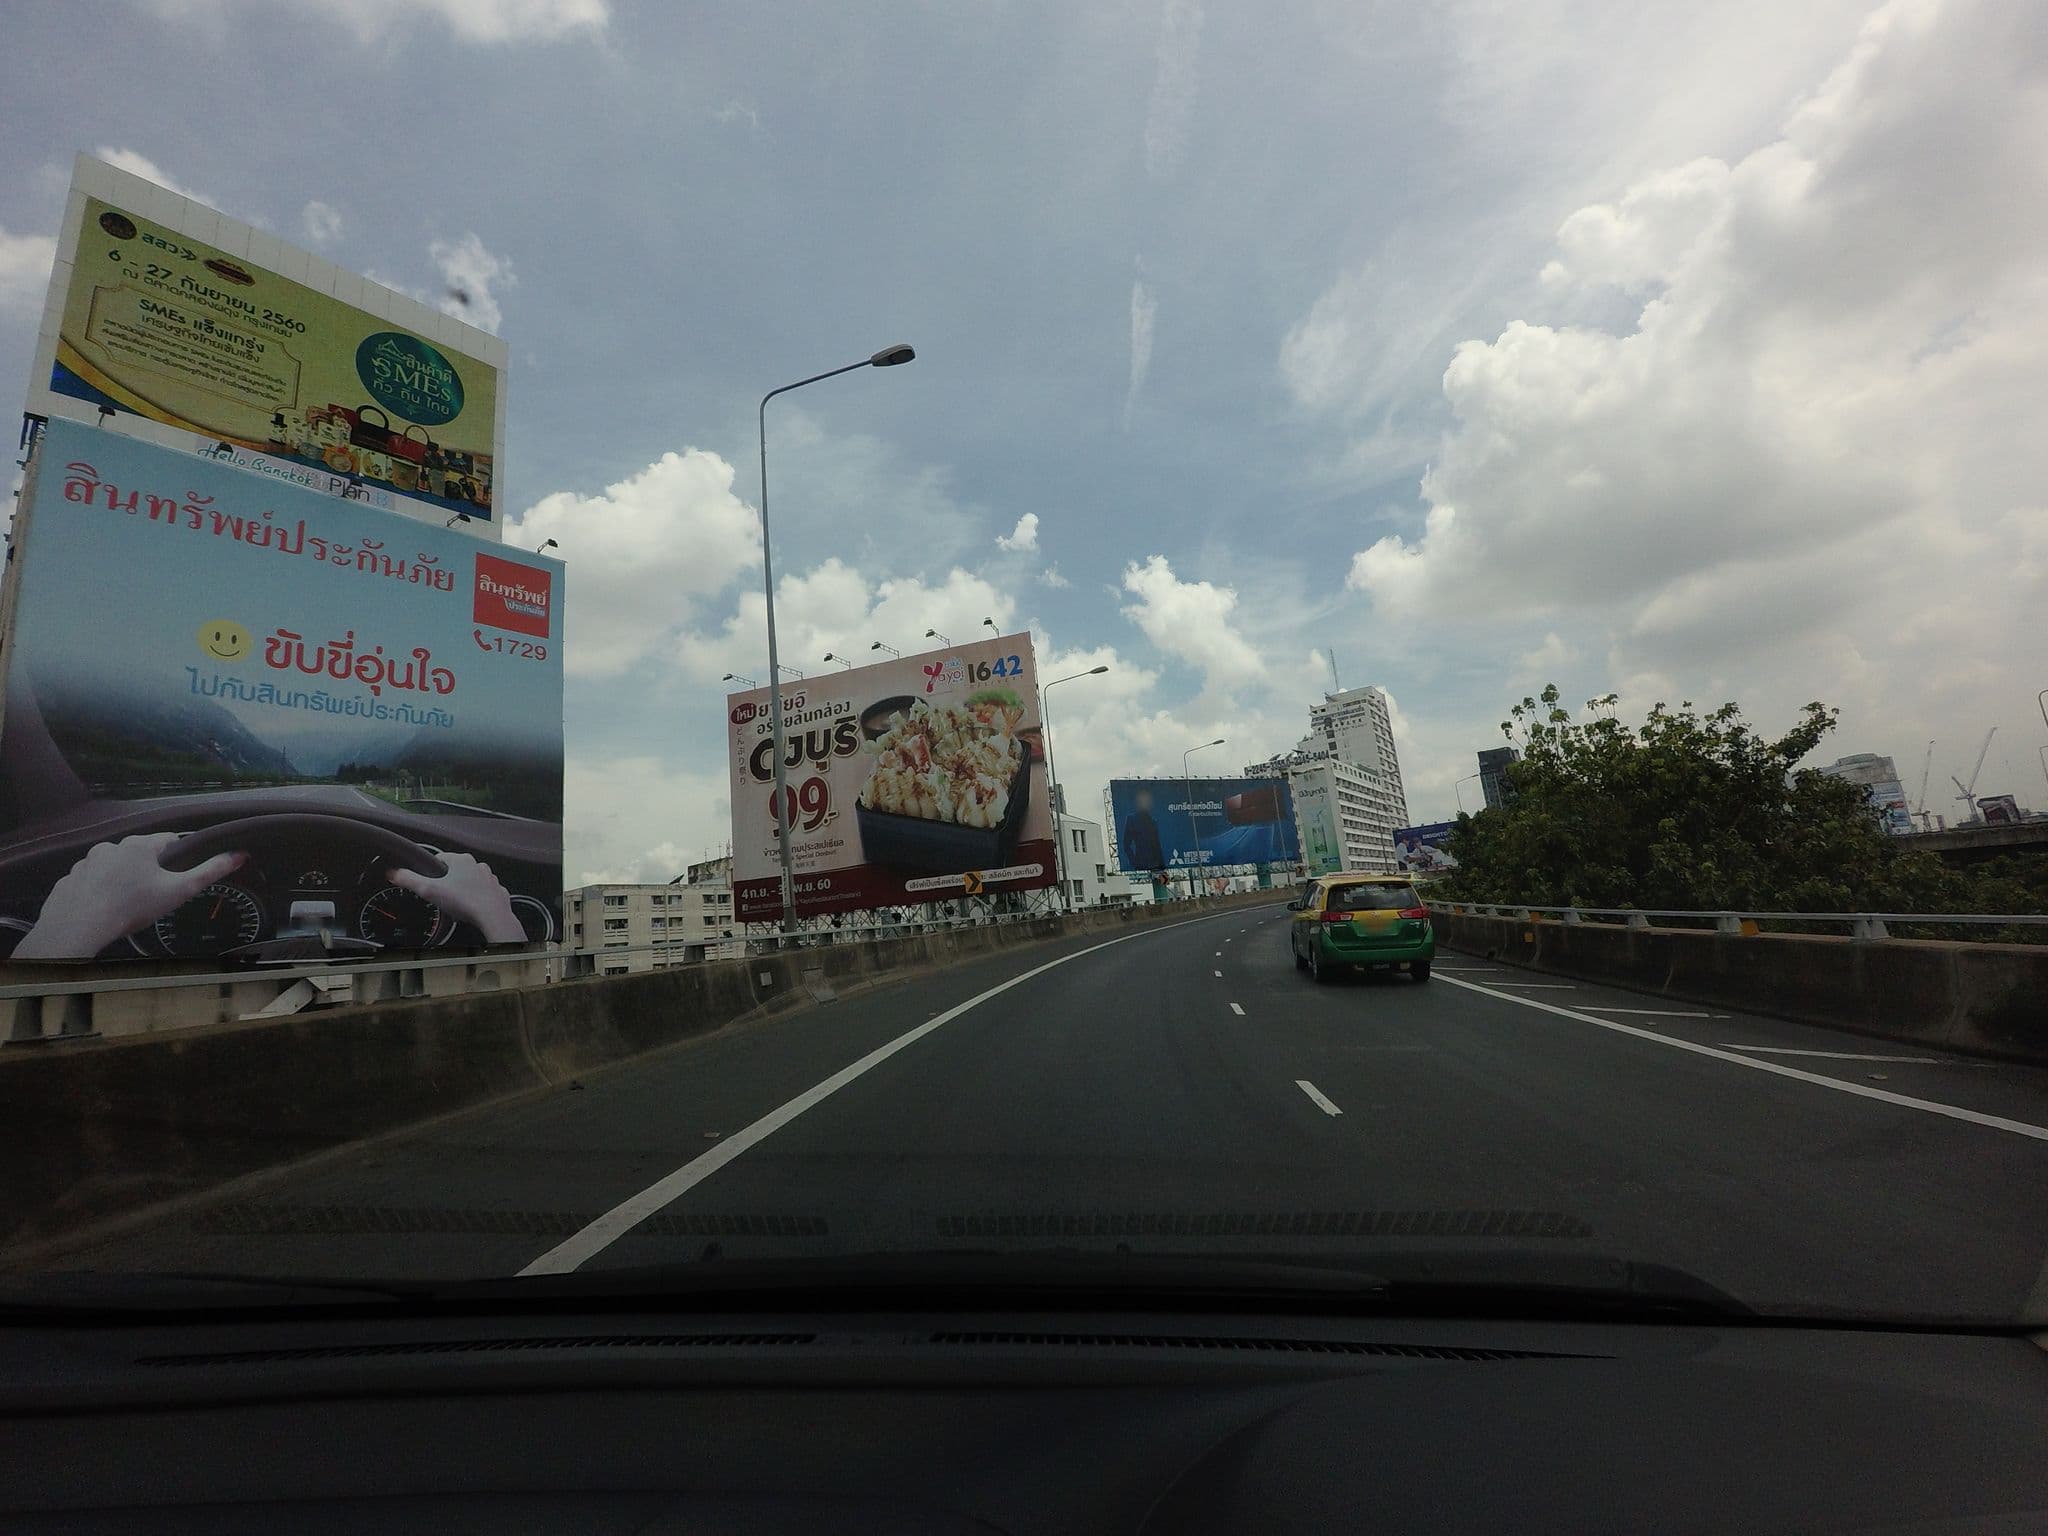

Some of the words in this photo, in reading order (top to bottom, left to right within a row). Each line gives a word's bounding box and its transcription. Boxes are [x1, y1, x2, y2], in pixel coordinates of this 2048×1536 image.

[108, 250, 121, 261] 6
[146, 264, 173, 279] 27
[181, 275, 255, 315] กันยายน
[263, 309, 305, 333] 2560
[139, 299, 185, 325] SMEs
[193, 319, 265, 353] แข็งแกร่ง
[426, 397, 450, 415] ไทย
[198, 442, 245, 466] Hello
[252, 458, 312, 487] Bangkok
[329, 478, 370, 502] Plan
[63, 461, 454, 592] สินทรัพย์ประกันภัย
[479, 574, 547, 606] สินทรัพย์
[264, 628, 456, 697] ขับขี่อุ่นใจ
[493, 637, 547, 661] 1729
[968, 655, 1023, 684] 1642
[185, 665, 454, 729] ไปกับสินทรัพย์ประกันภัย
[817, 878, 831, 890] 60
